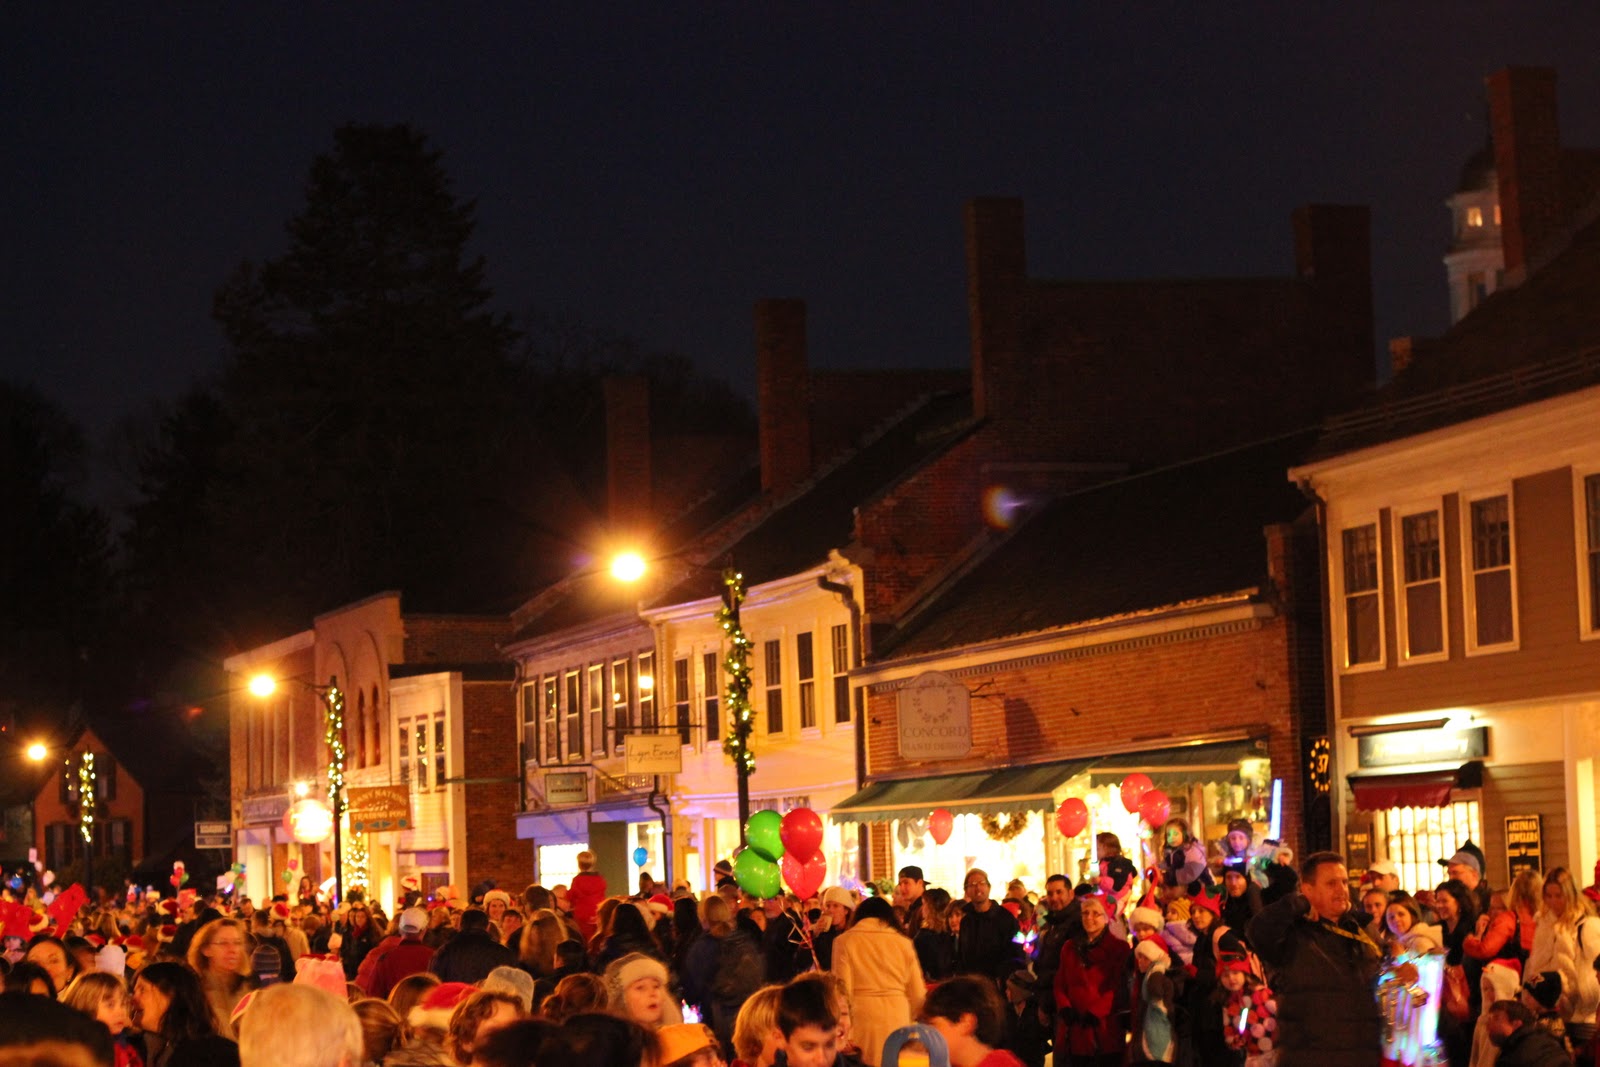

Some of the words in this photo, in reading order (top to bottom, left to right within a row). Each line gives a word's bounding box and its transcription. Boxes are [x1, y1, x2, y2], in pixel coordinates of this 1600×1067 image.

[903, 727, 967, 738] CONCORD
[904, 743, 931, 752] HAND
[1317, 754, 1328, 773] 37
[352, 811, 387, 821] TRADING
[389, 810, 406, 818] POST
[1508, 831, 1538, 844] JEWELERS
